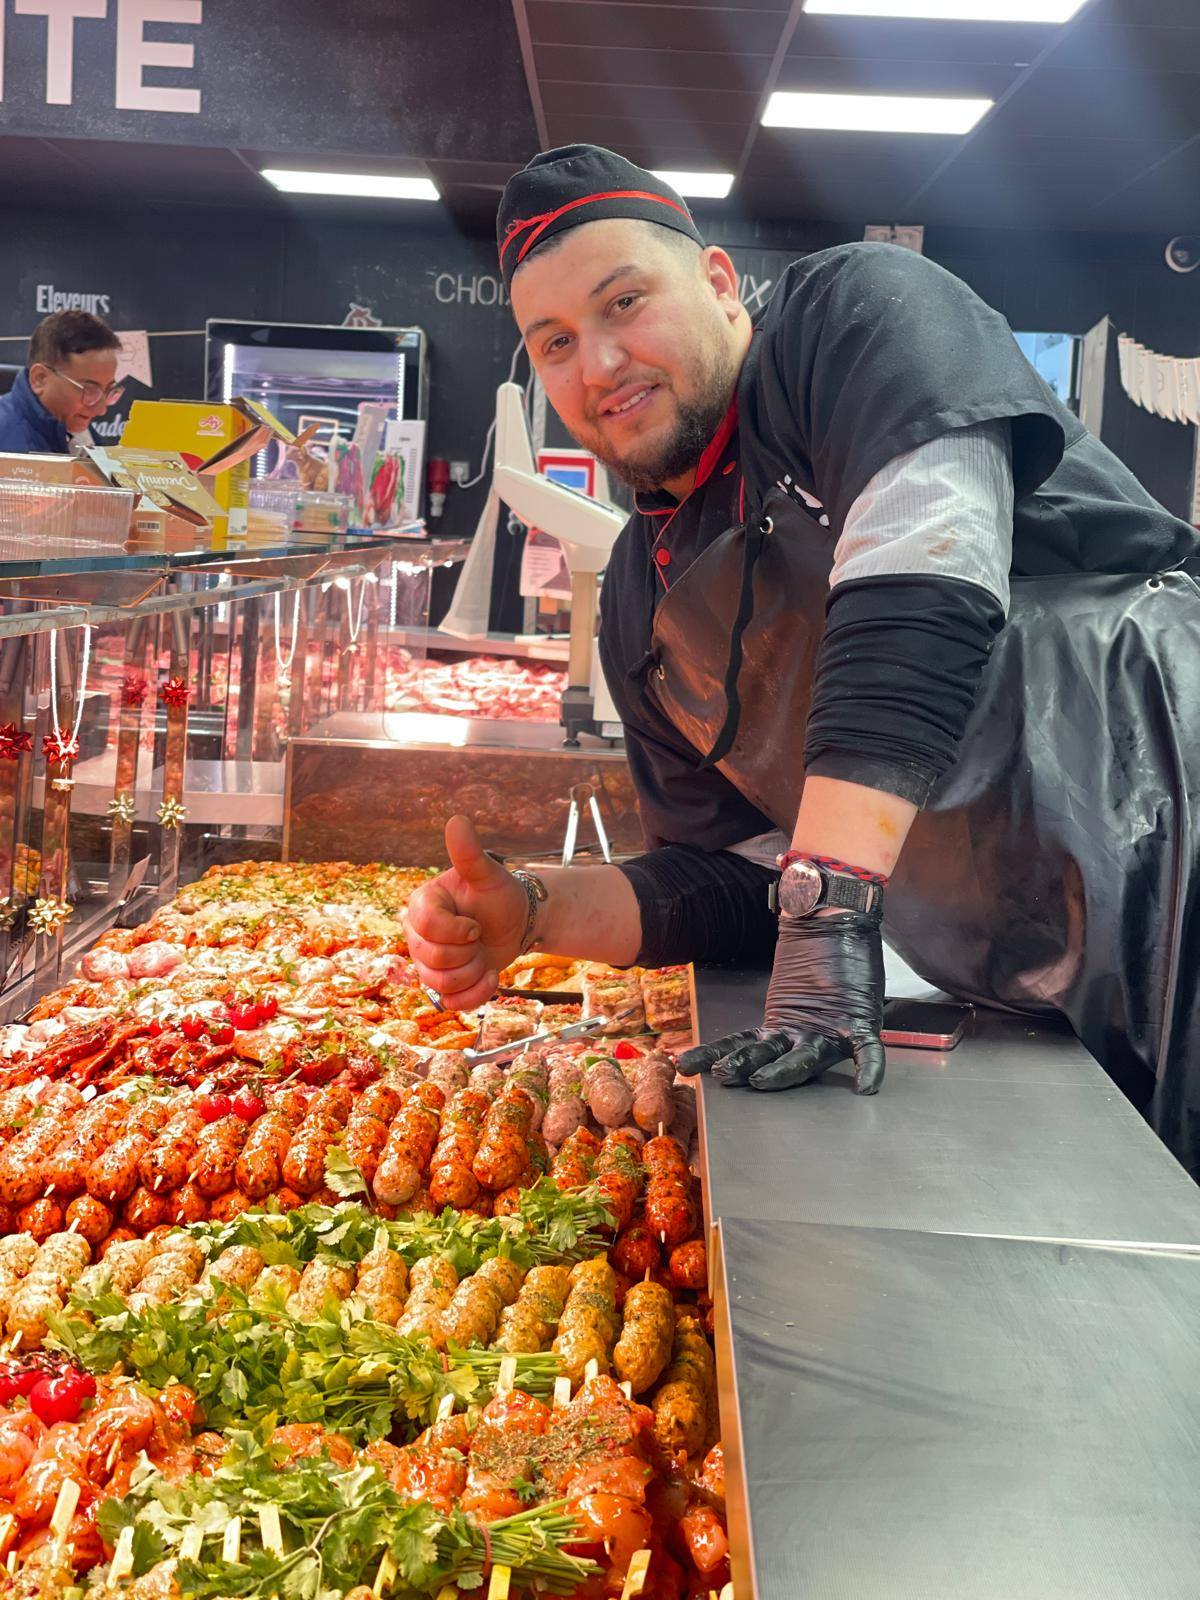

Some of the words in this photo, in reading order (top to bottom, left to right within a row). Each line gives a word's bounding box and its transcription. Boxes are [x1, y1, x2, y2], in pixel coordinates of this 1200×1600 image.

[0, 0, 202, 113] TE
[36, 284, 110, 315] Eleveurs
[435, 273, 510, 305] CHOI
